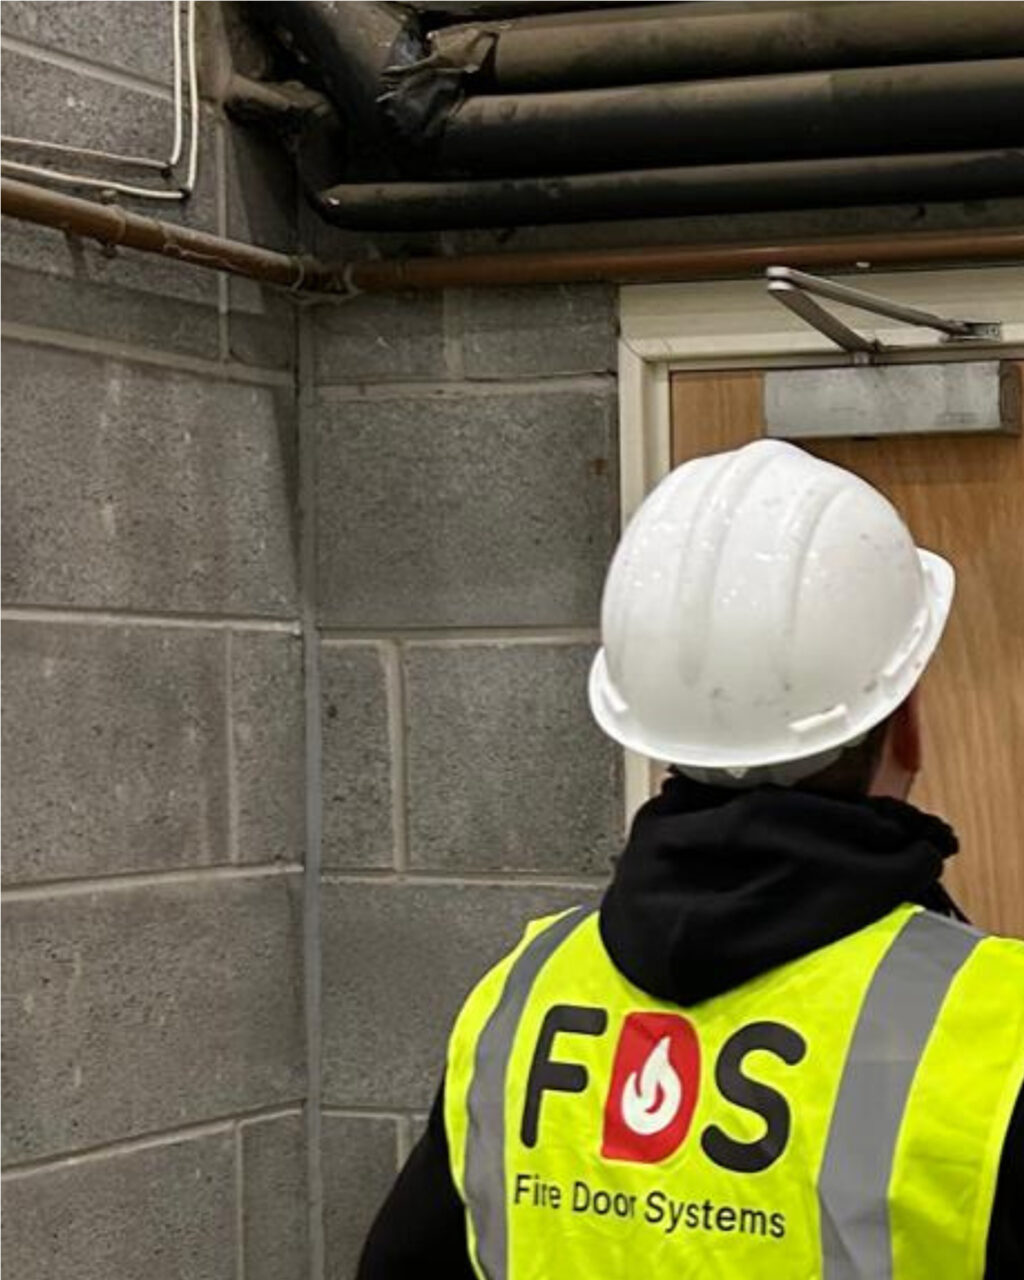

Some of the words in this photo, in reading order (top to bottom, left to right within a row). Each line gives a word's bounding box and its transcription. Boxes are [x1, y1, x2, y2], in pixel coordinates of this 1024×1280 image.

[520, 1003, 807, 1174] FDS
[513, 1173, 562, 1210] Fire
[571, 1180, 637, 1219] Door
[643, 1190, 787, 1239] Systems
